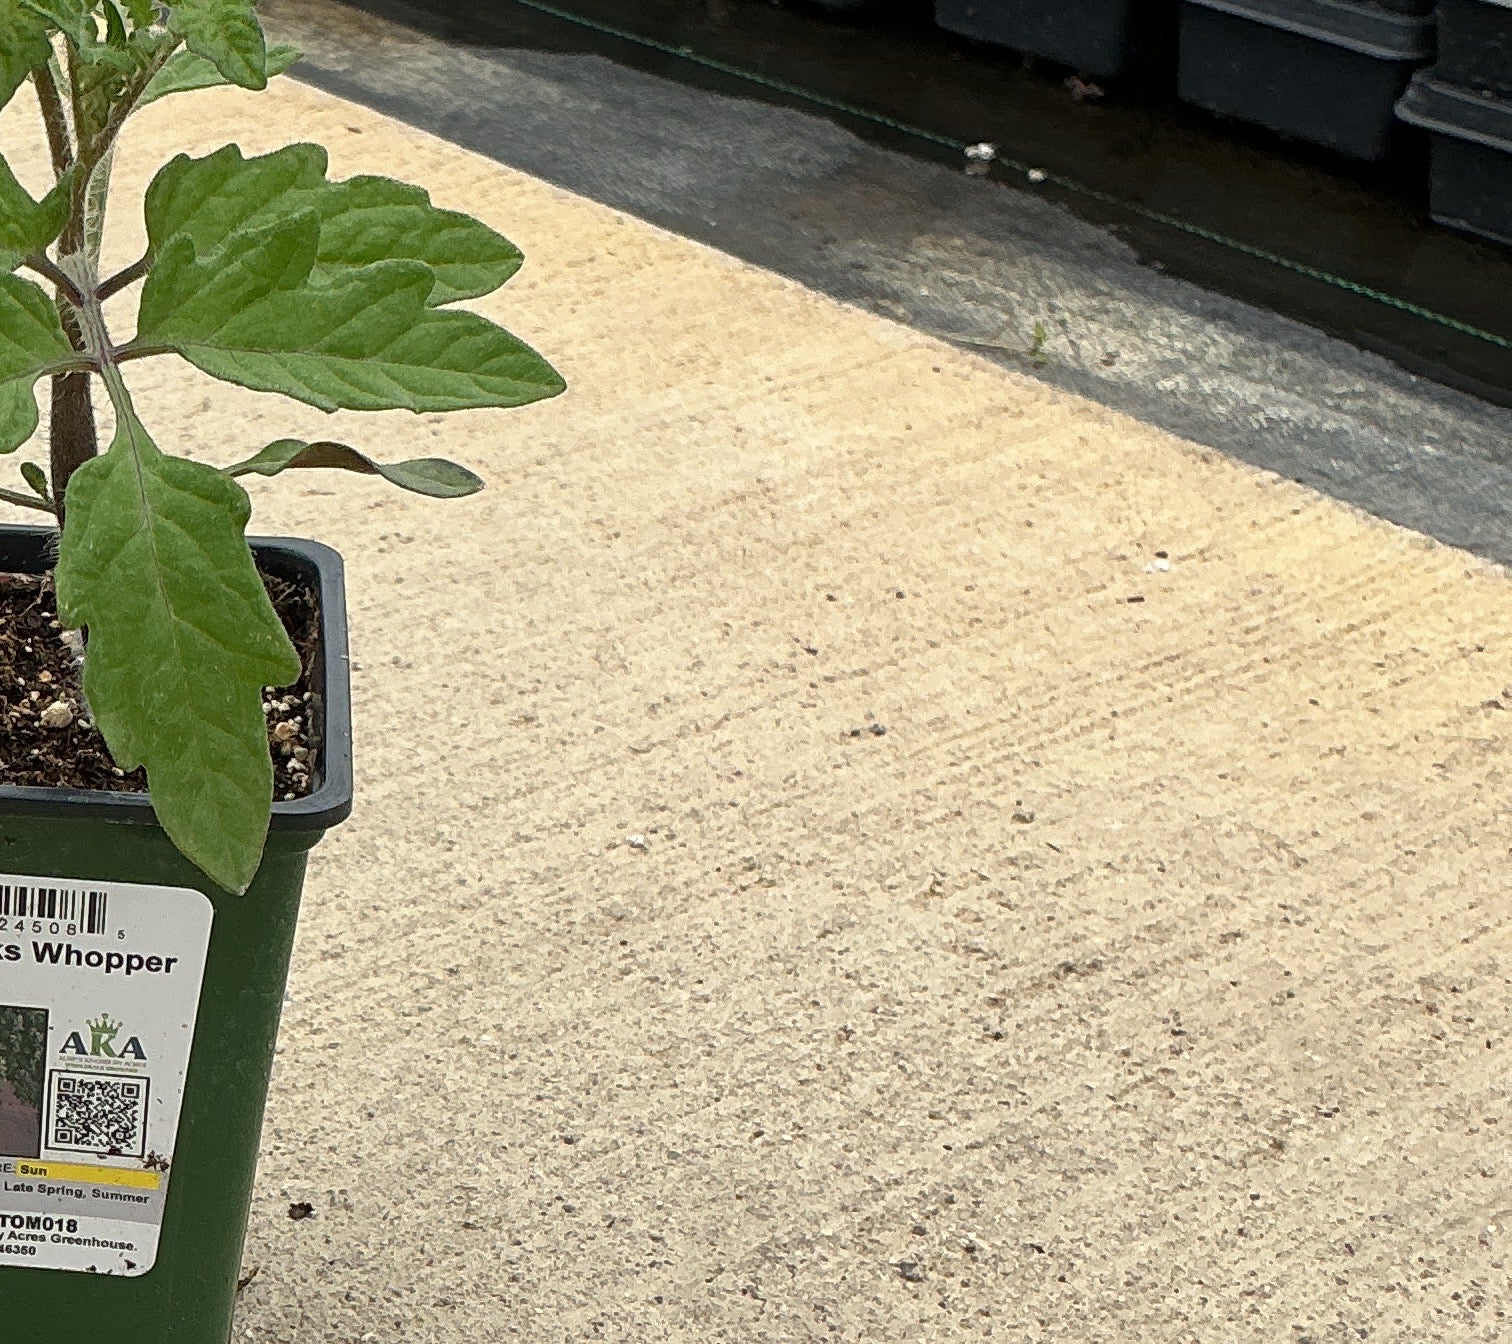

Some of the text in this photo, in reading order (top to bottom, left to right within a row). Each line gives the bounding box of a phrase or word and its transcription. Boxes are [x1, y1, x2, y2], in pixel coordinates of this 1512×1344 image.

[117, 929, 126, 940] 5
[32, 940, 179, 976] Whopper
[59, 1031, 148, 1061] AKA
[20, 1164, 48, 1177] Sun
[4, 1181, 34, 1193] Late
[37, 1183, 87, 1199] Spring,
[91, 1188, 150, 1204] Summer
[7, 1230, 47, 1243] Acres
[50, 1233, 138, 1252] Greenhouse.
